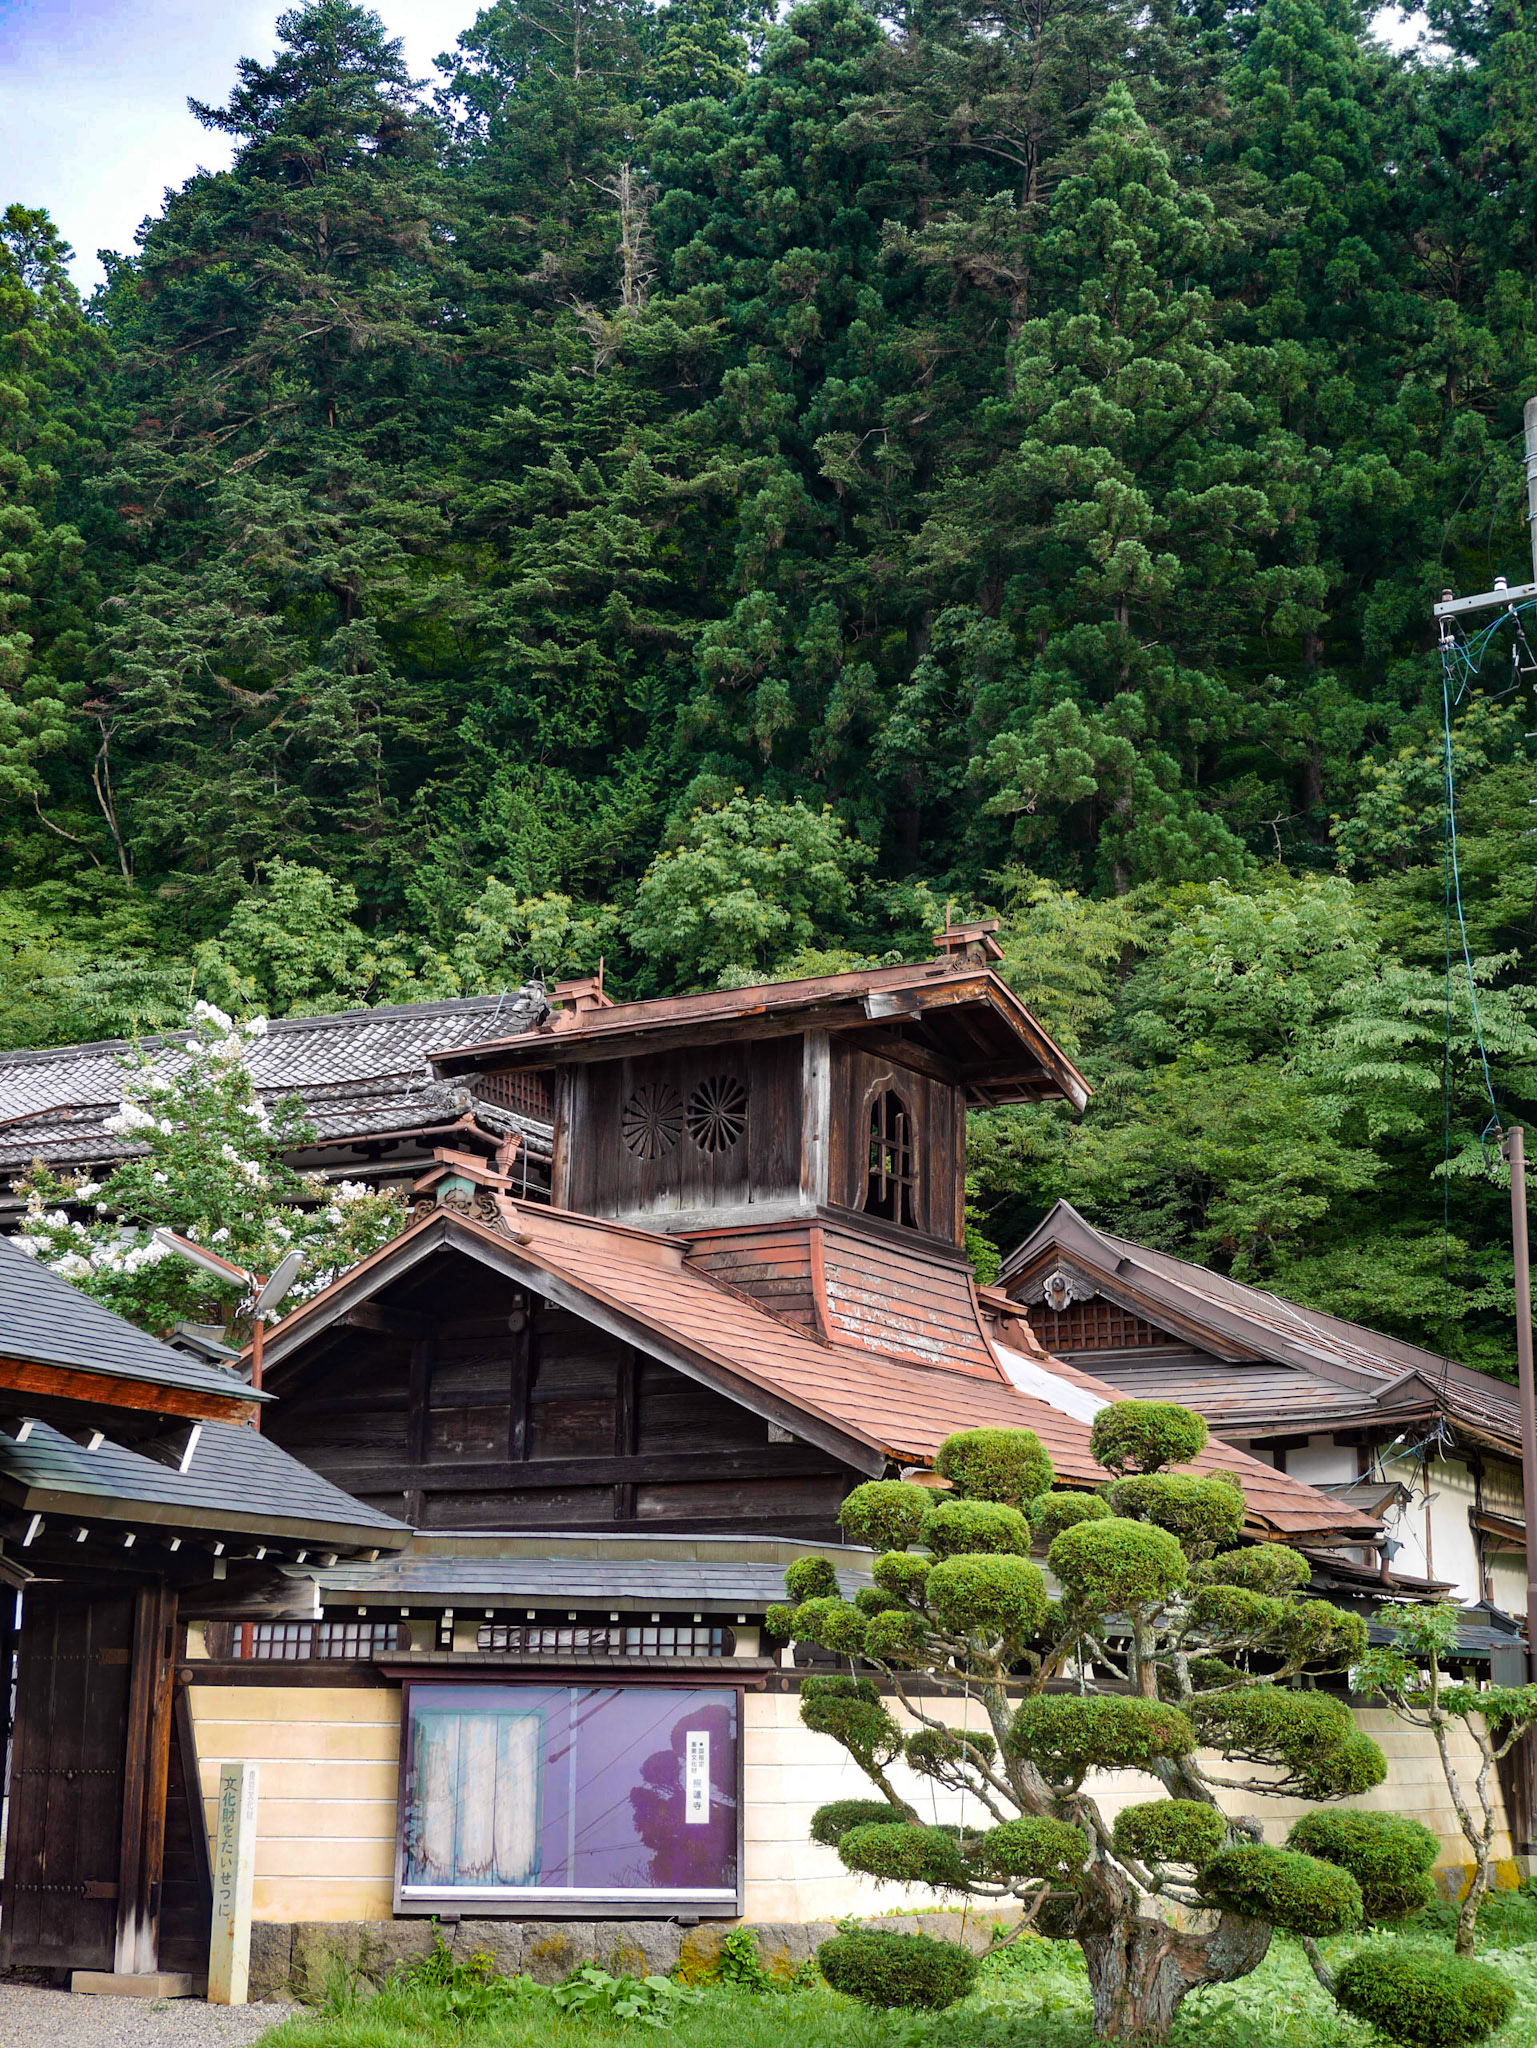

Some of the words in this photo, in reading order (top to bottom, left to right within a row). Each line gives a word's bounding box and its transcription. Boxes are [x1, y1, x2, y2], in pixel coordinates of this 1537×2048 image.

[218, 1776, 238, 1918] 文化財をたいせつに
